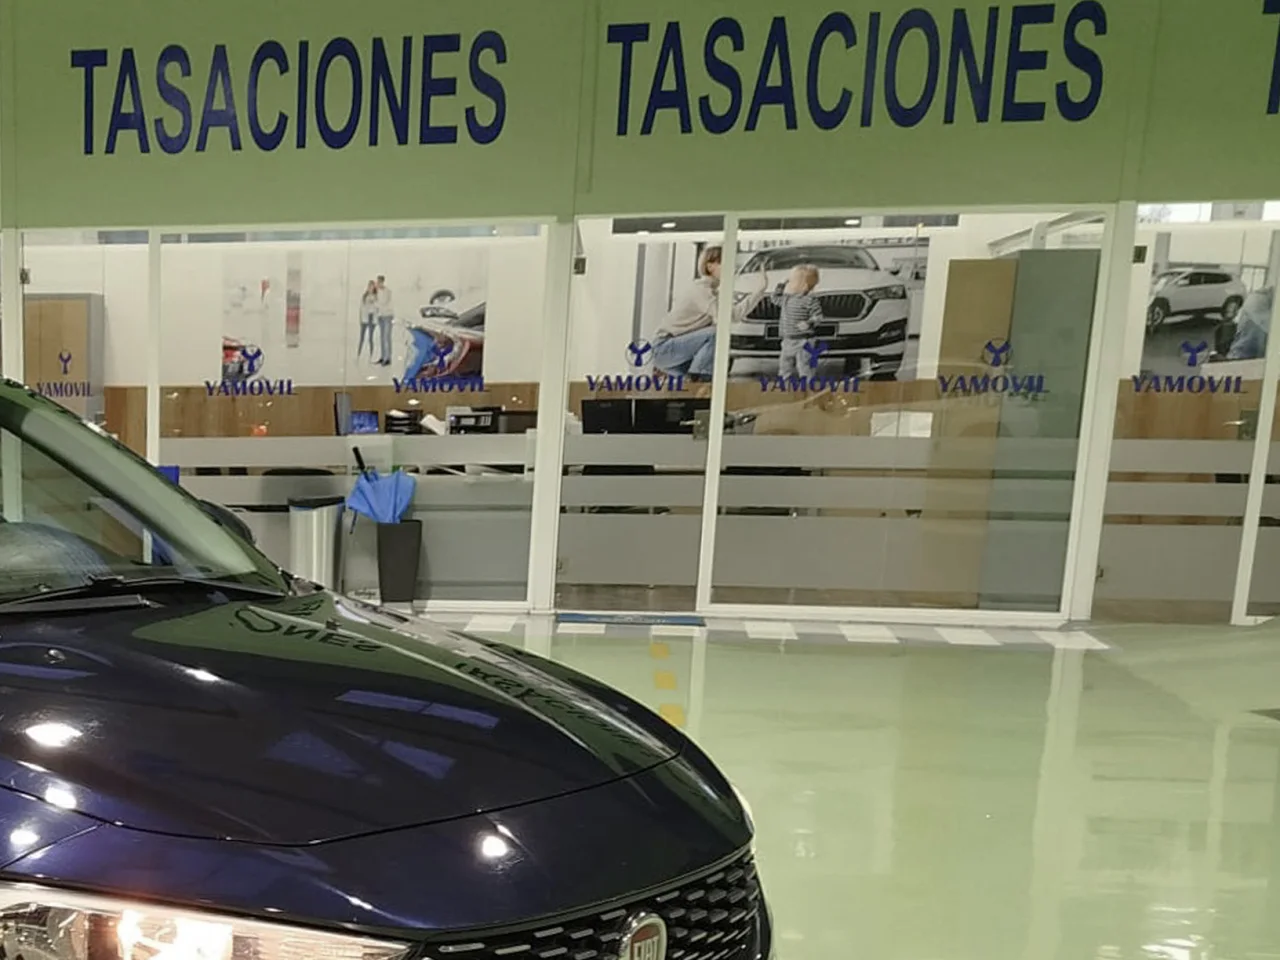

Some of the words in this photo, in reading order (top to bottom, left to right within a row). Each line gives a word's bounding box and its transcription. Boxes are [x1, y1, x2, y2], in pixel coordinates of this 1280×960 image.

[608, 0, 1107, 136] TASACIONES
[71, 30, 507, 155] TASACIONES
[37, 381, 94, 398] YAMOVIL
[205, 378, 298, 397] YAMOVIL
[392, 376, 490, 394] YAMOVIL
[586, 374, 688, 392] YAMOVIL
[758, 375, 865, 394] YAMOVIL
[937, 374, 1050, 394] YAMOVIL
[1131, 374, 1249, 394] YAMOVIL
